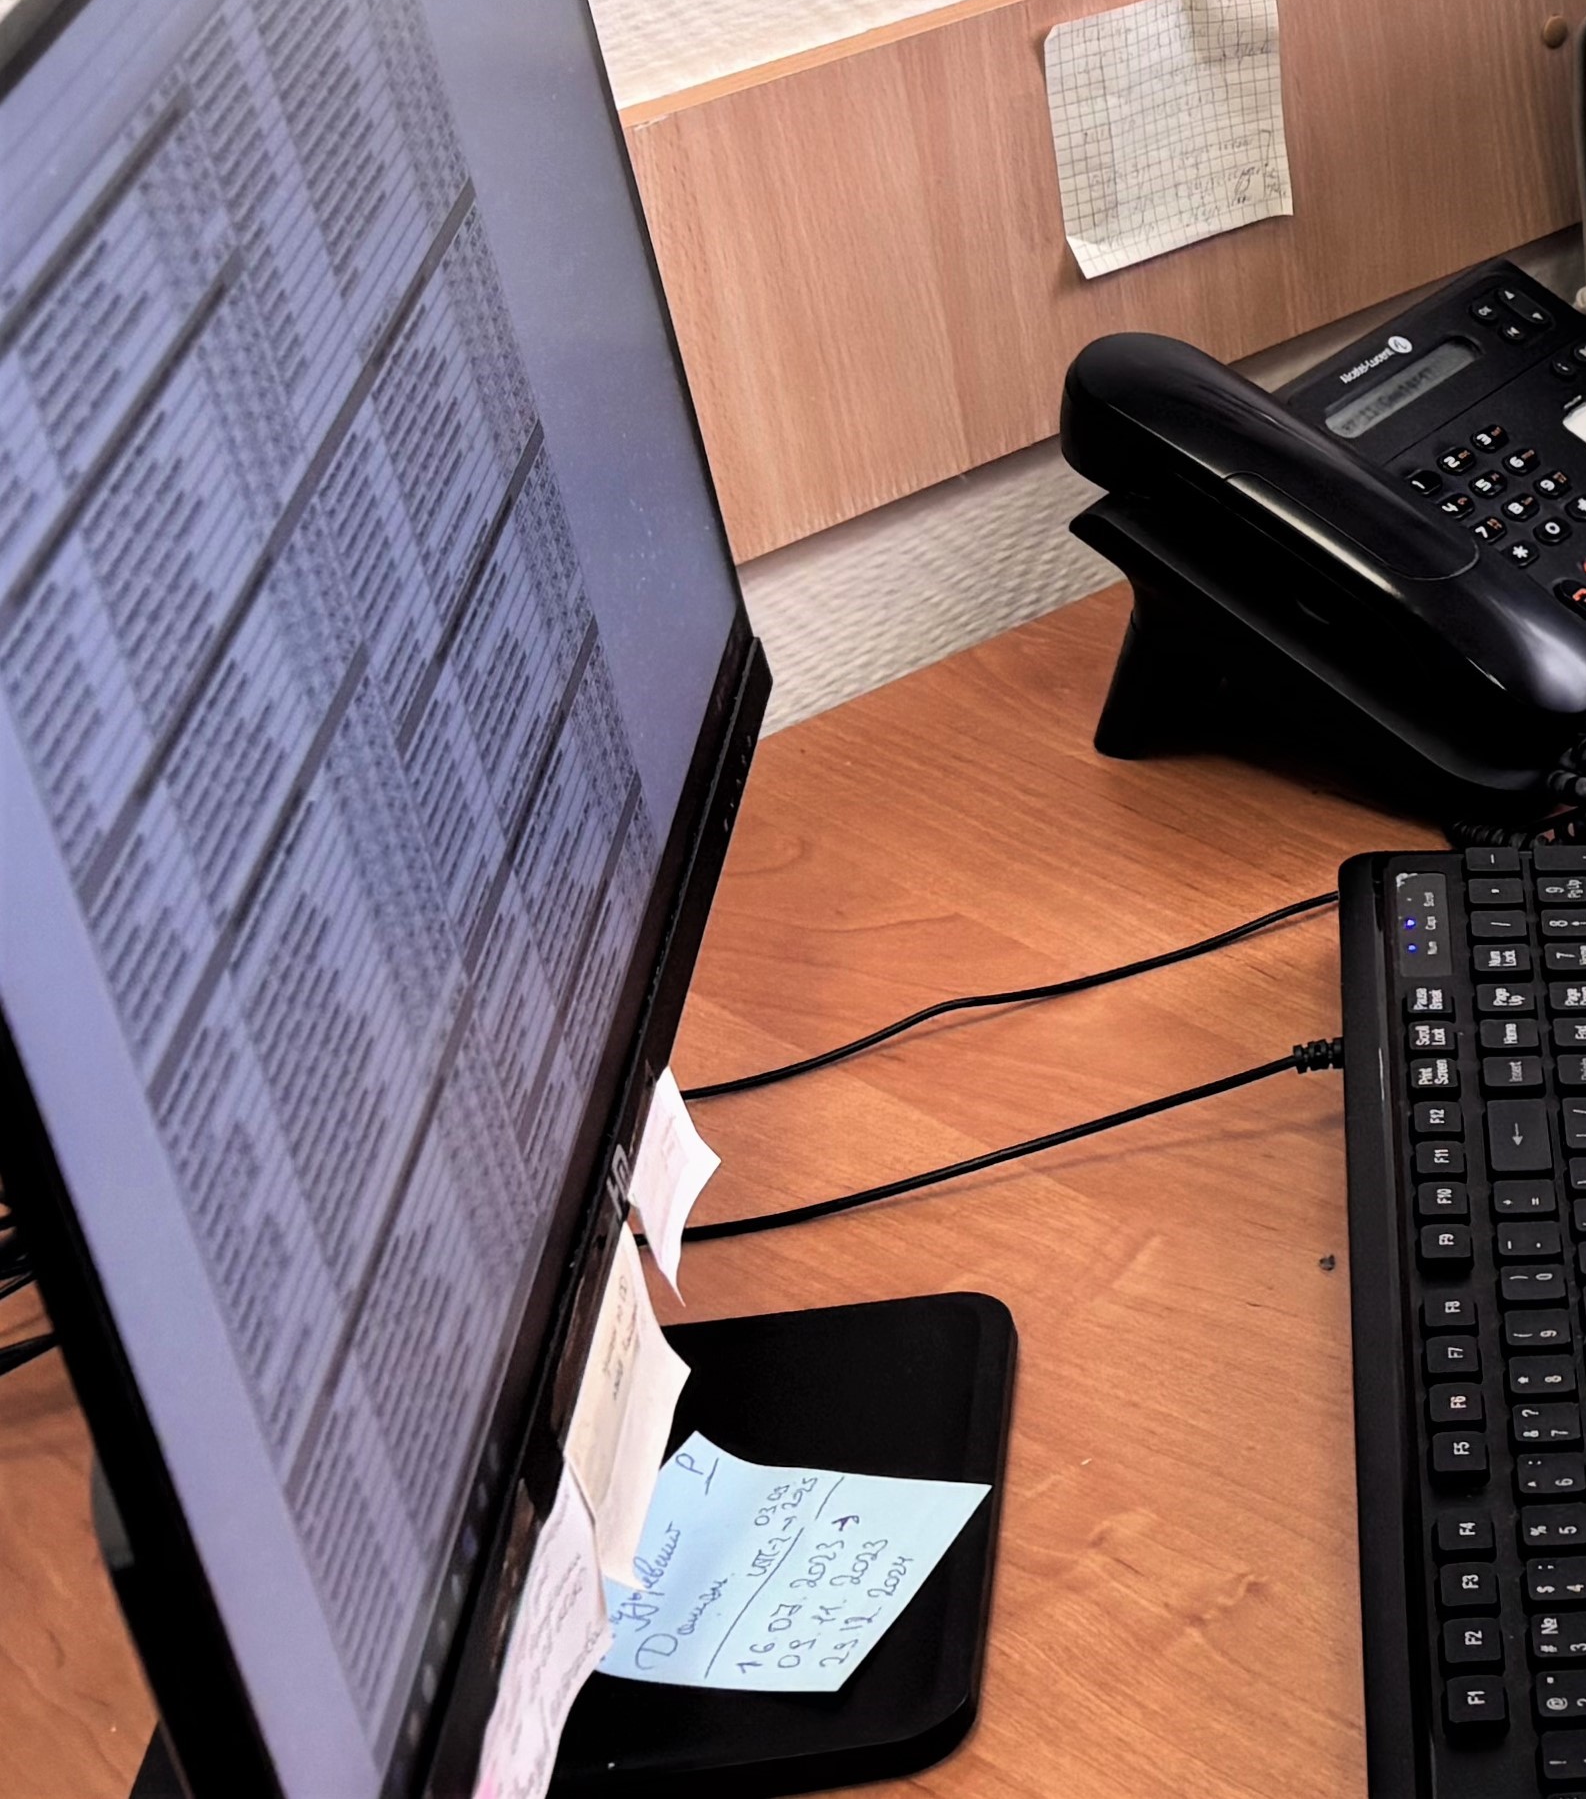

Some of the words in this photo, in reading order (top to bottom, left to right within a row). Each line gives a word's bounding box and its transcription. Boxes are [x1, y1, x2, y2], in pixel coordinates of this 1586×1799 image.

[1430, 1109, 1445, 1124] F12
[1434, 1149, 1450, 1163] F11
[1437, 1188, 1452, 1204] F10
[1448, 1346, 1464, 1359] F7
[1450, 1395, 1467, 1408] F6
[1453, 1441, 1470, 1456] F5
[1459, 1522, 1476, 1536] F4
[1462, 1574, 1479, 1589] F3
[1465, 1630, 1483, 1646] F2
[1467, 1690, 1485, 1705] F1
